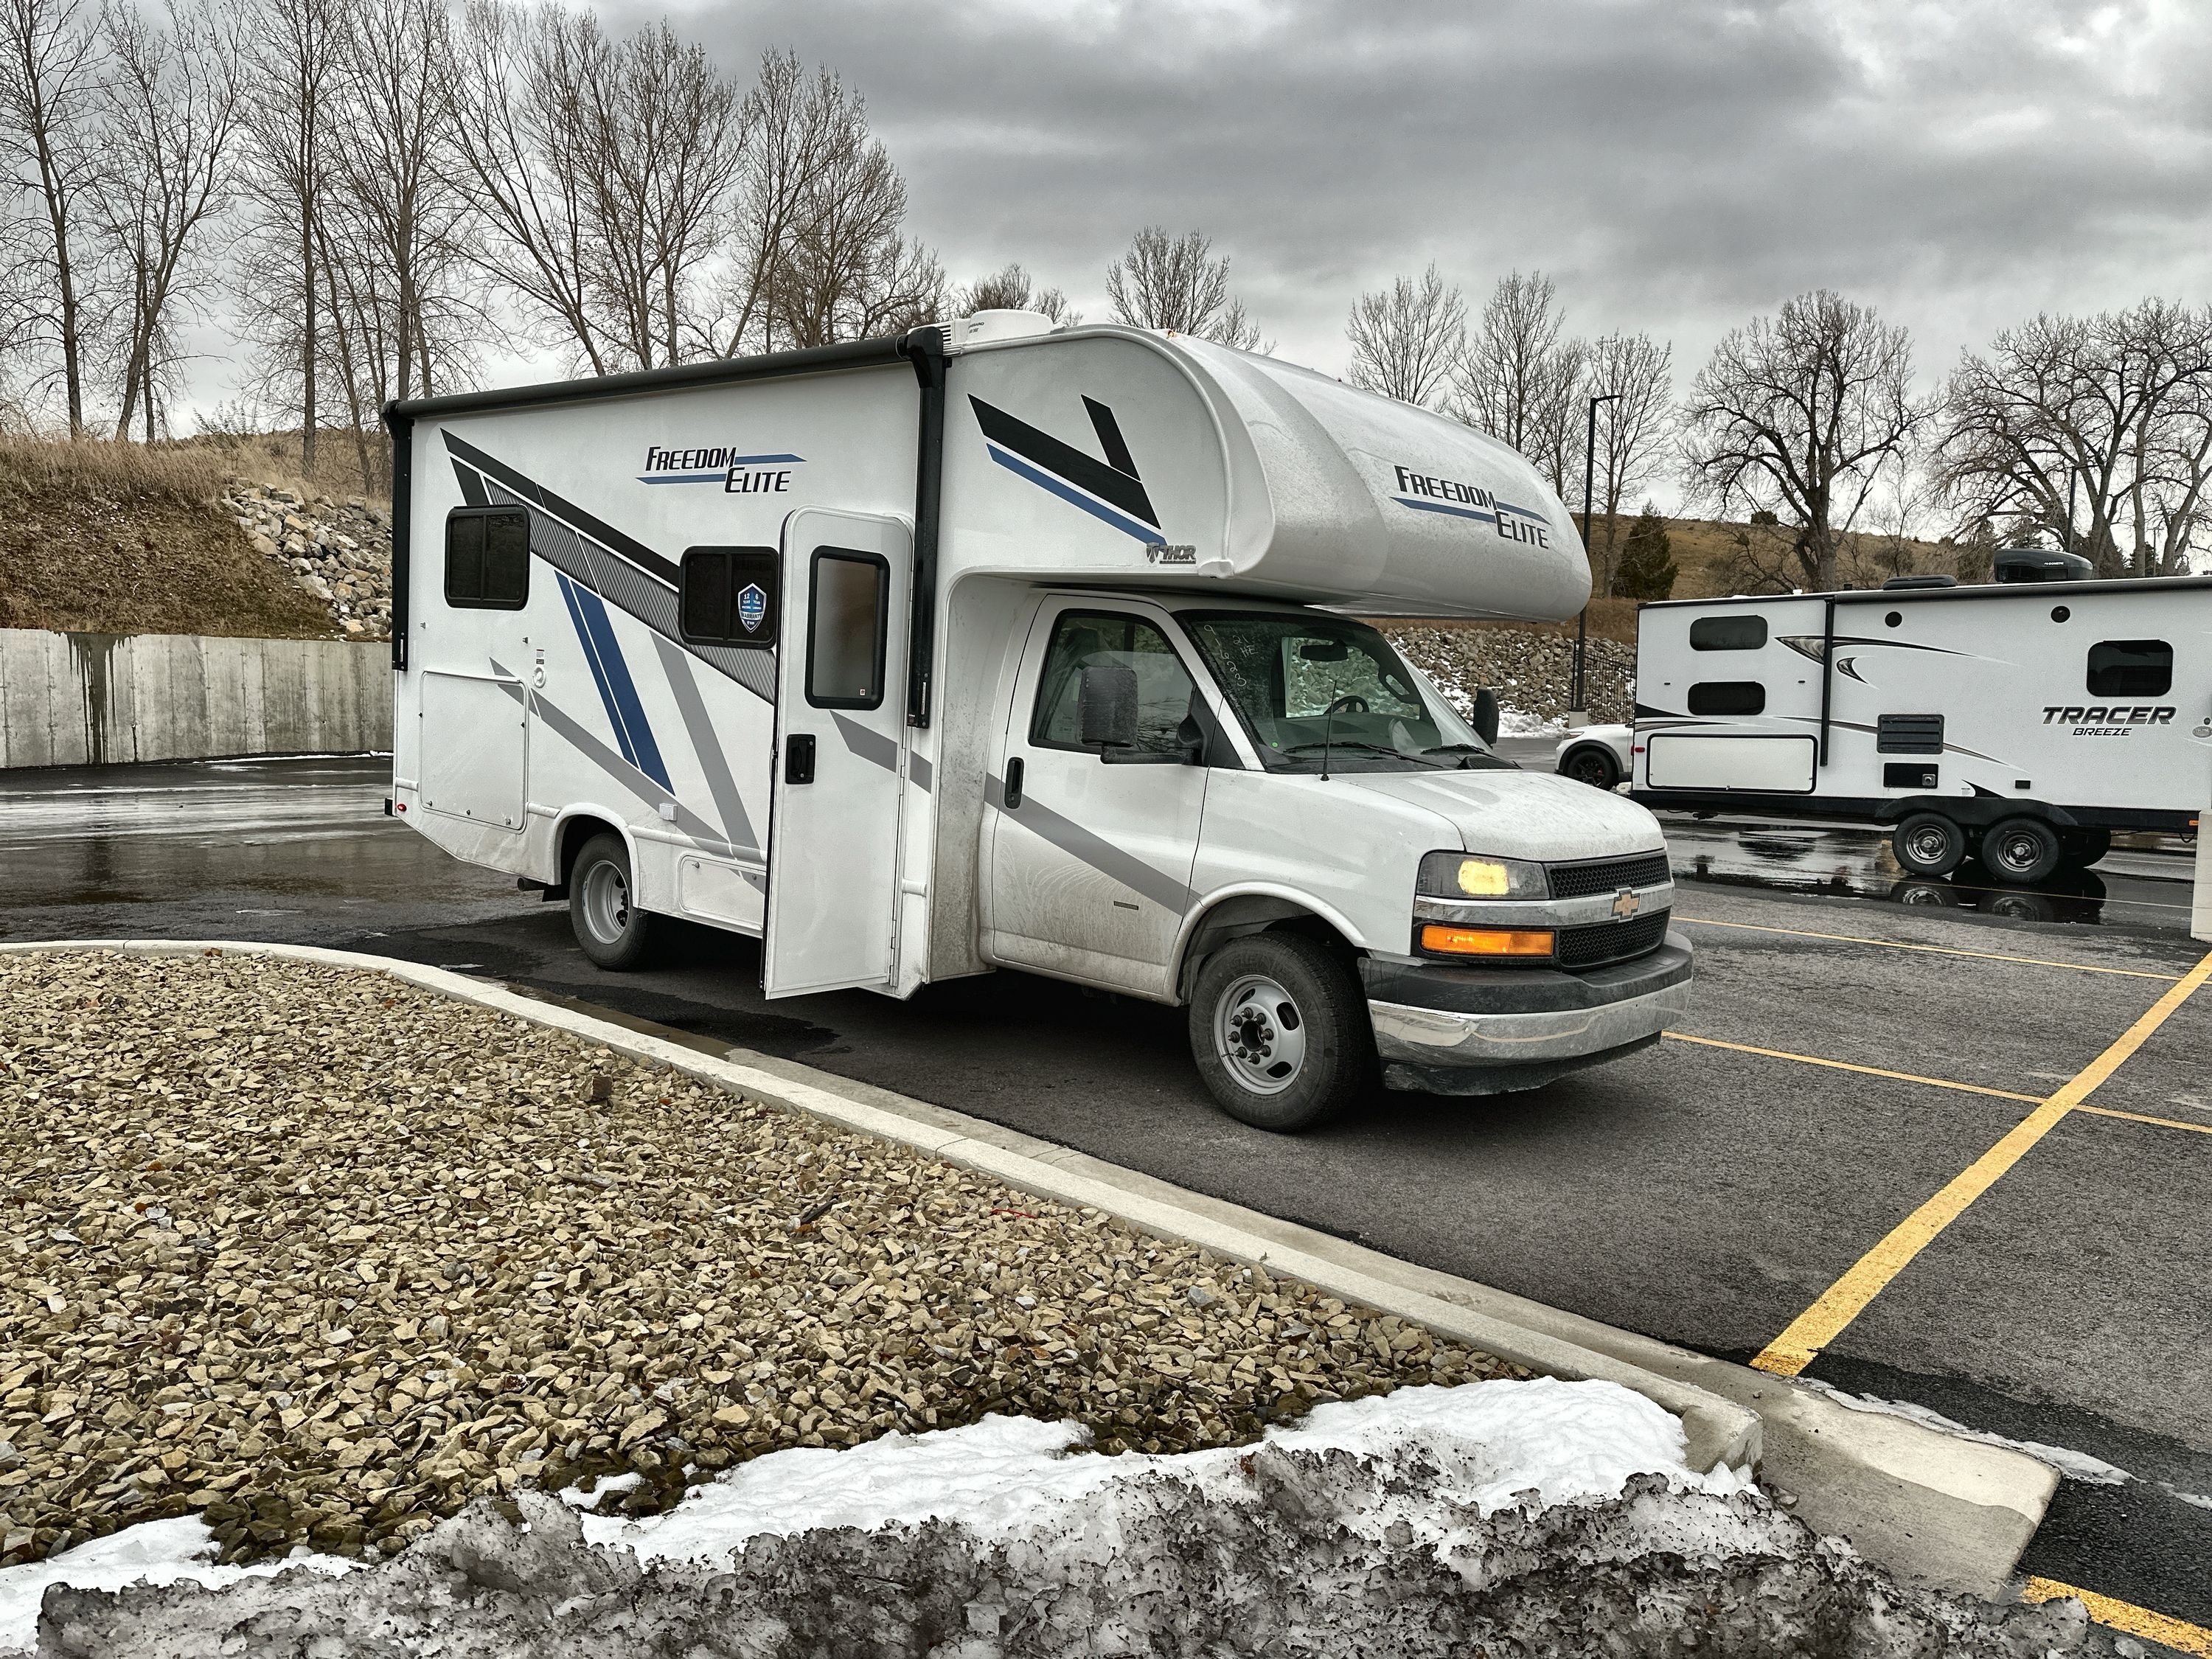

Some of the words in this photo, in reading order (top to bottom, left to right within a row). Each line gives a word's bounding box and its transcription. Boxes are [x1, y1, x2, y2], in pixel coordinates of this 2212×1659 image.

[645, 446, 737, 471] FREEDOM
[725, 467, 791, 493] ELITE
[1394, 465, 1498, 511] FREEDOM
[1495, 510, 1548, 549] ELITE
[1159, 545, 1197, 560] THOR
[2042, 706, 2177, 725] TRACER
[2072, 728, 2132, 736] BREEZE
